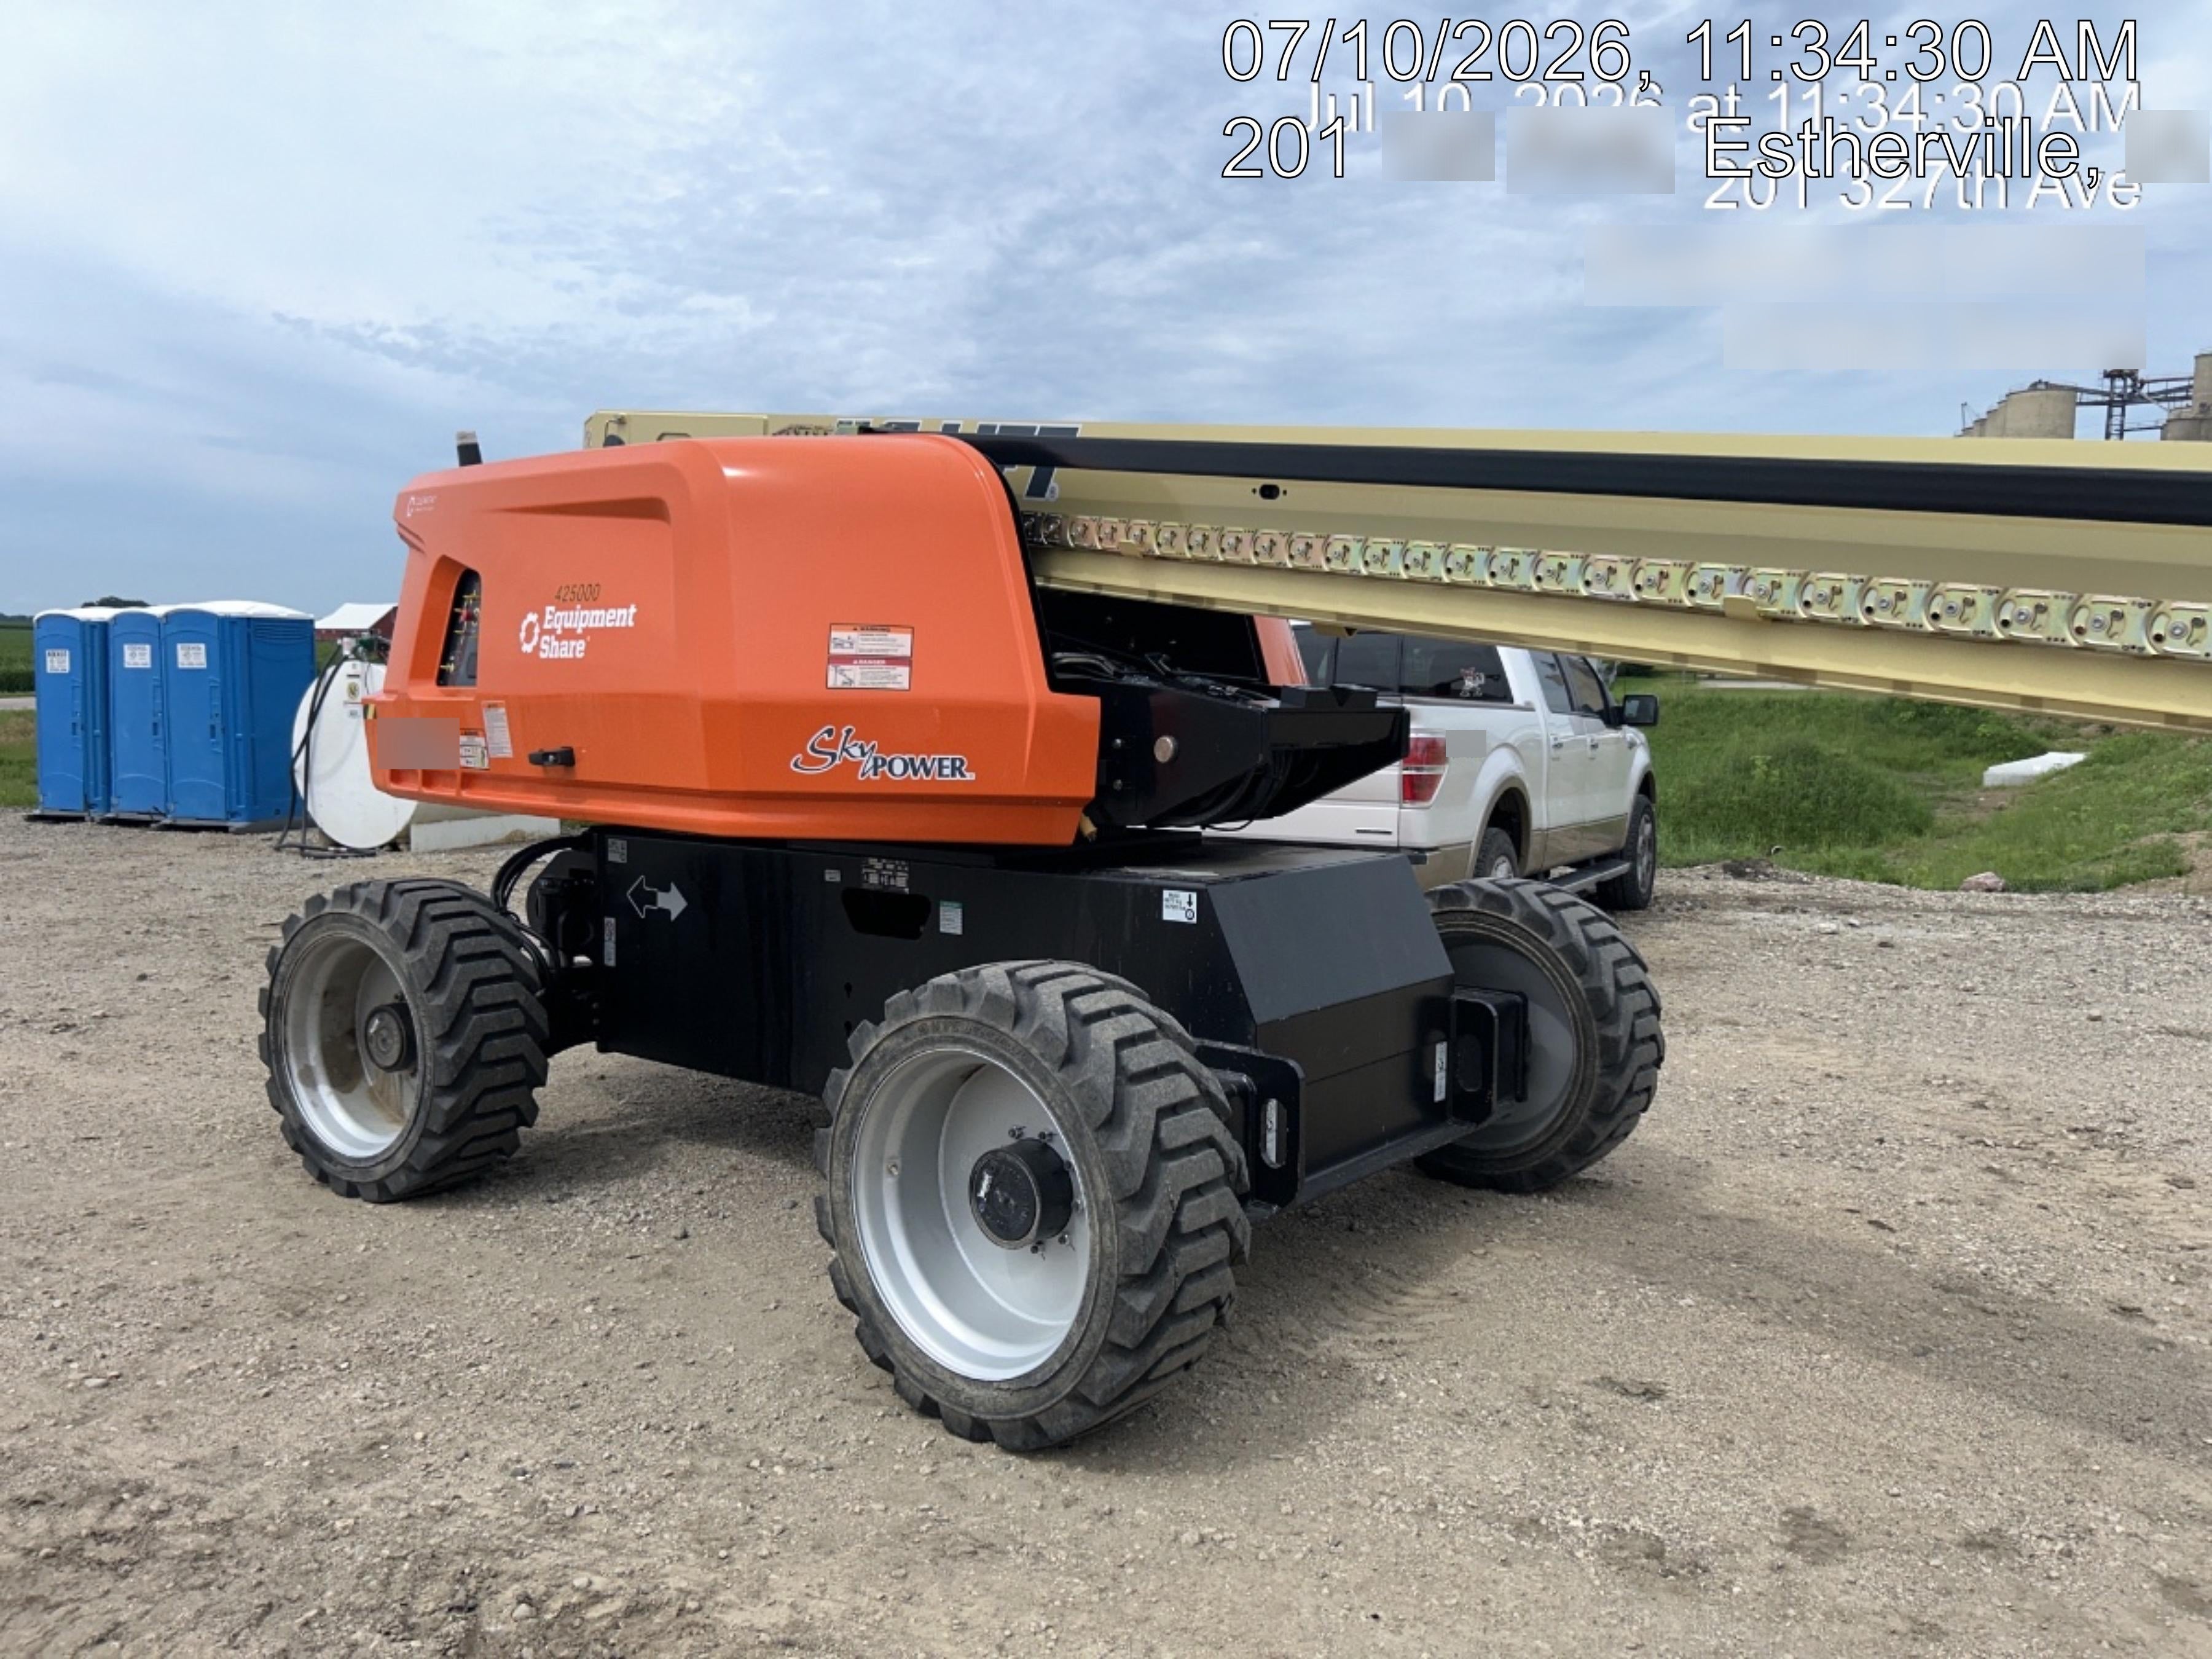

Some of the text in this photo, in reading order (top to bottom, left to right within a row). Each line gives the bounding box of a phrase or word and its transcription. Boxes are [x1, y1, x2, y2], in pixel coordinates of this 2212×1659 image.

[555, 583, 601, 602] 425000
[543, 603, 638, 635] Equipment
[539, 635, 586, 659] Share
